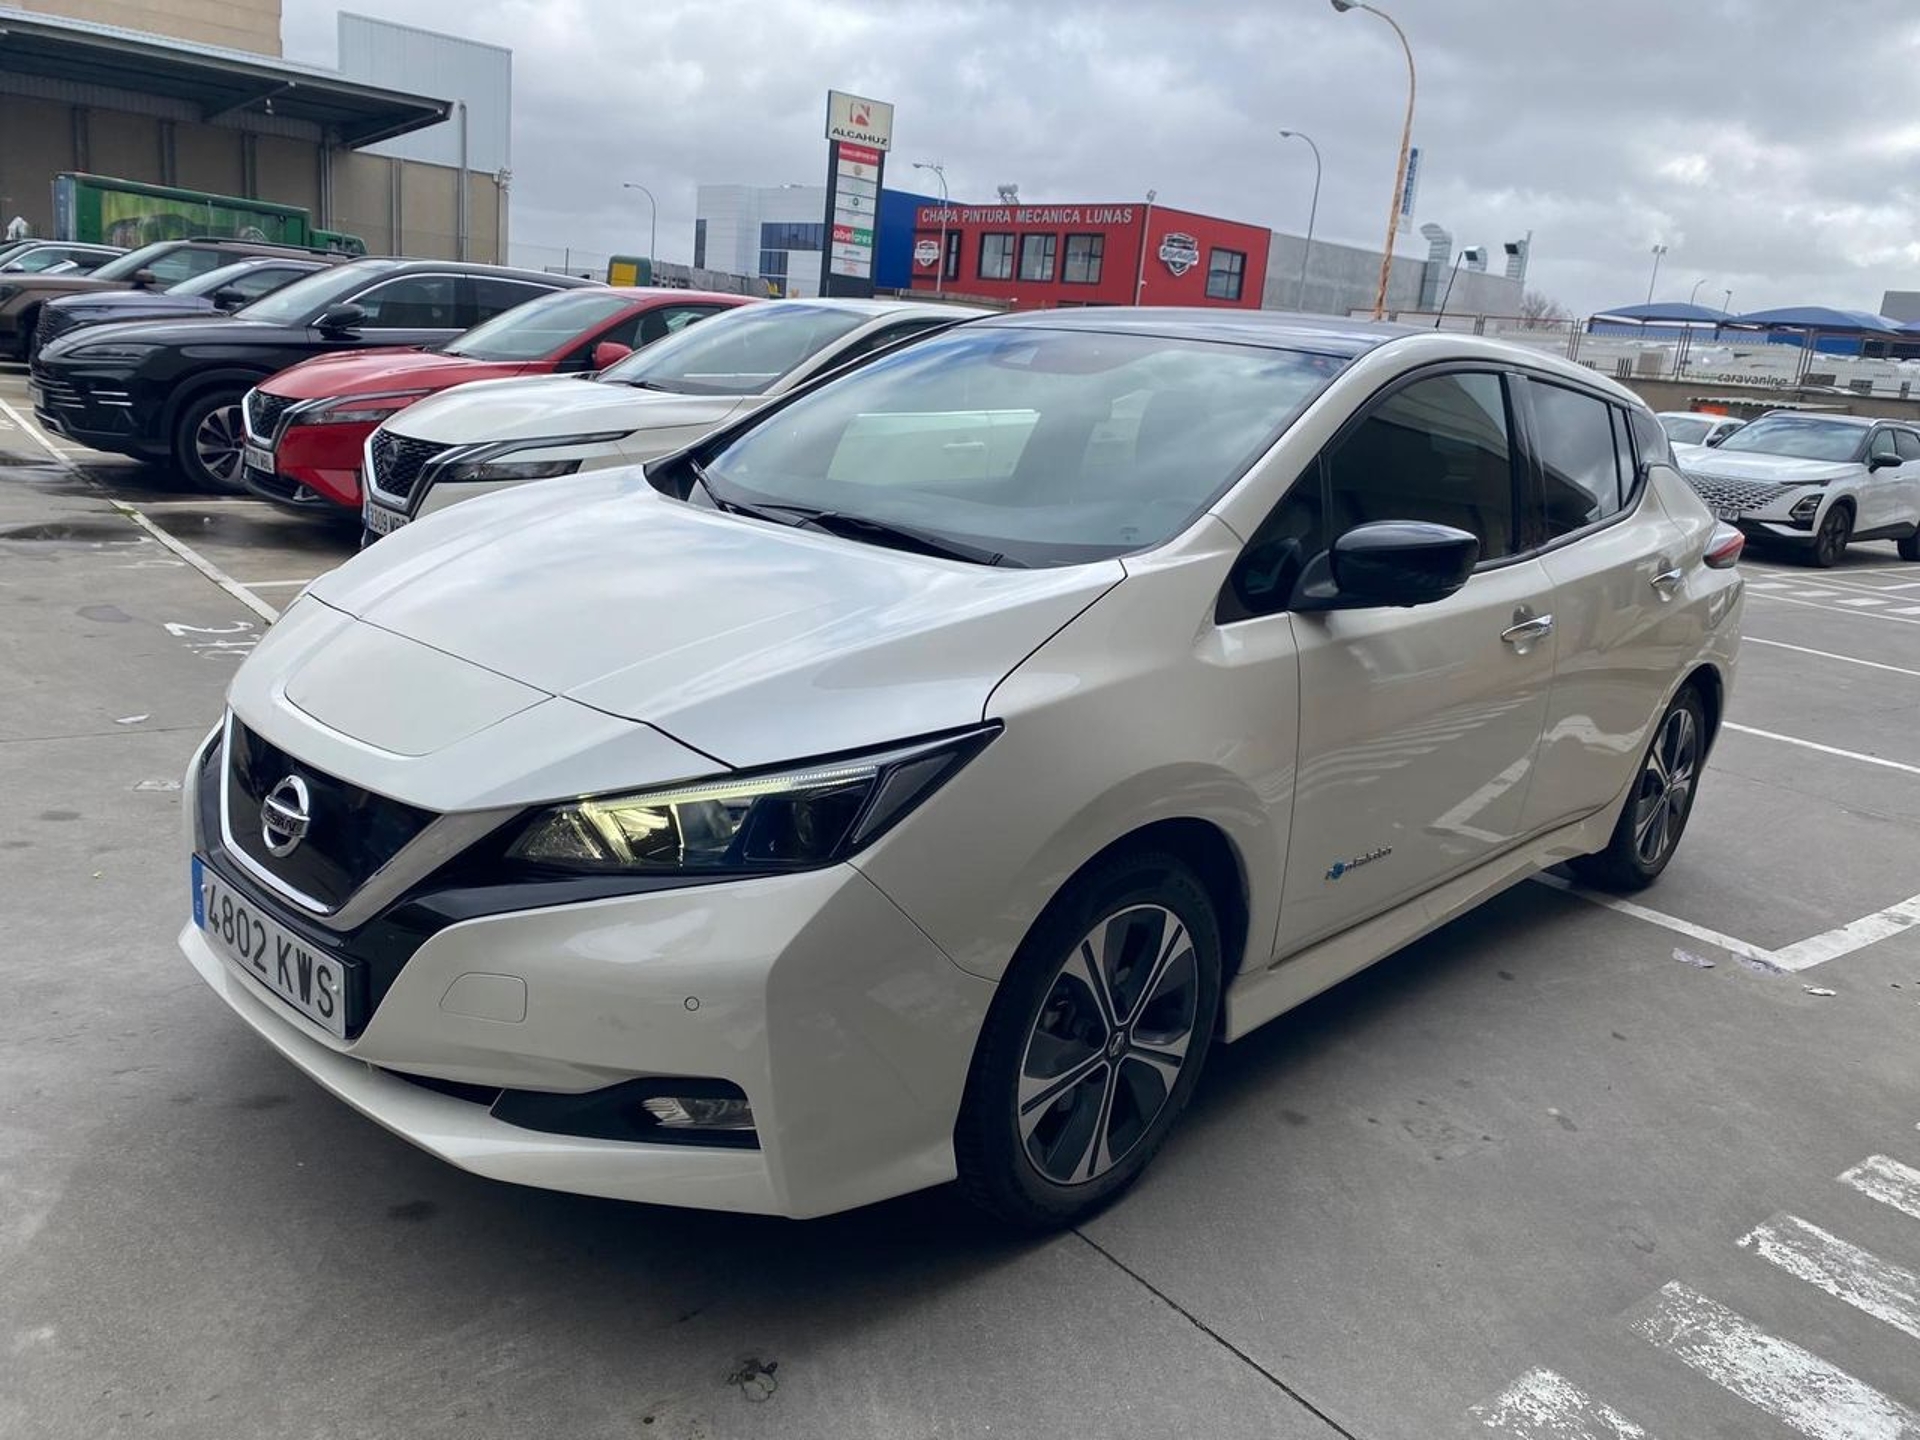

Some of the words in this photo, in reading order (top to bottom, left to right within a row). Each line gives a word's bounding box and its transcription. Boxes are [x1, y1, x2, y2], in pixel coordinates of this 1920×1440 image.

[832, 127, 887, 145] ALCAHUZ
[922, 208, 957, 222] CHAPA
[962, 209, 1011, 223] PINTURA
[1015, 209, 1080, 223] MECANICA
[1086, 208, 1132, 223] LUNAS
[209, 884, 267, 974] 4802
[277, 935, 334, 1018] KWS
